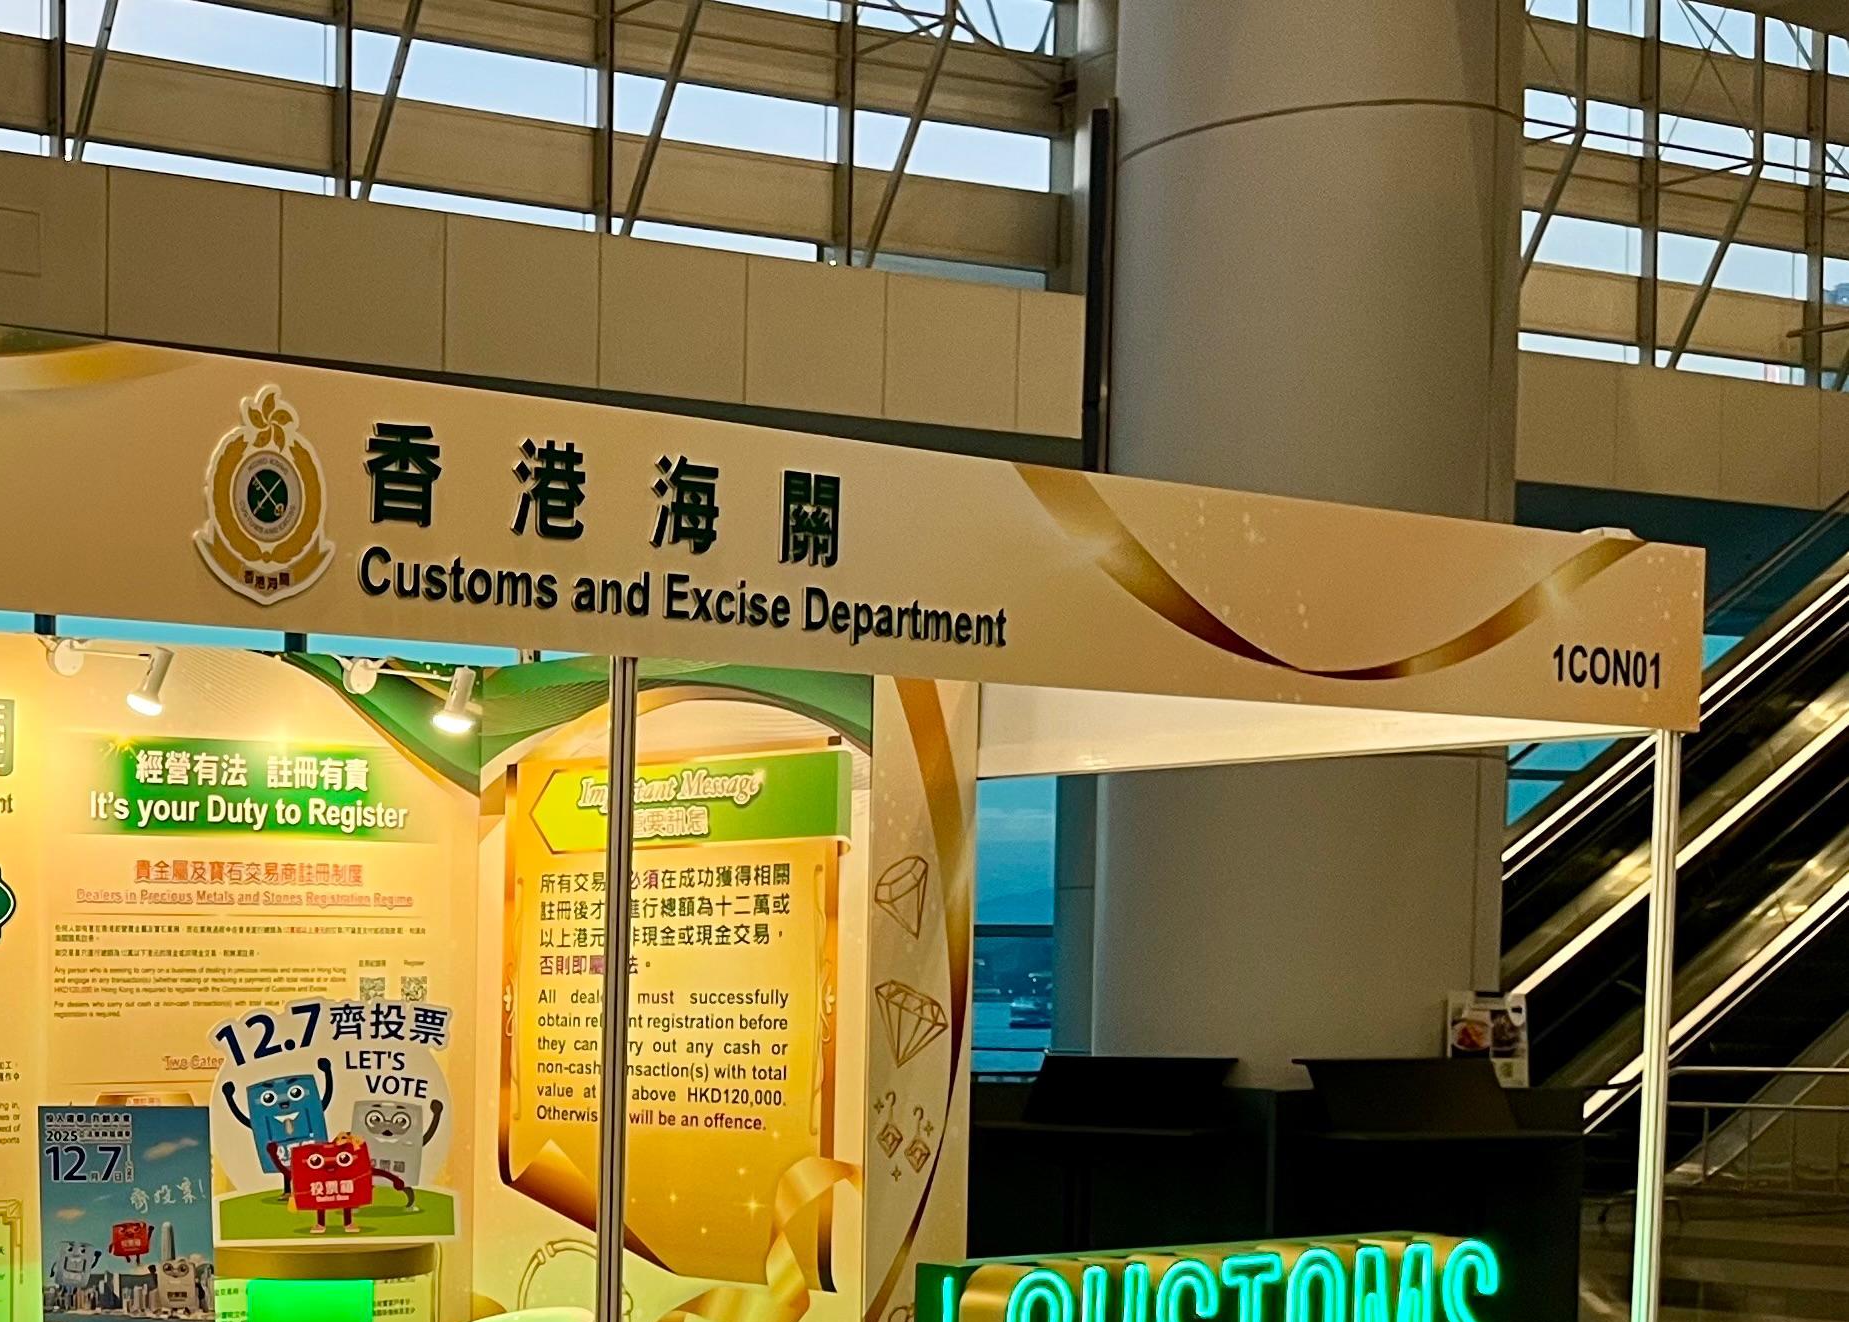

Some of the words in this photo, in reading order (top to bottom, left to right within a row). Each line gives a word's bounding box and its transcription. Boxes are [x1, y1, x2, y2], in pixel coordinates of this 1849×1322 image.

[363, 420, 843, 567] 香港海關
[358, 545, 558, 608] Customs
[572, 571, 646, 617] and
[663, 573, 791, 629] Excise
[803, 585, 1008, 647] Department
[1553, 644, 1662, 689] 1CON01
[135, 749, 248, 787] 經營有法
[266, 754, 369, 792] 註冊有責
[679, 770, 760, 803] Message
[89, 791, 129, 820] It's
[137, 795, 199, 828] your
[207, 794, 268, 832] Duty
[275, 798, 301, 825] to
[309, 798, 408, 834] Register
[540, 863, 791, 894] 所有交易必須在成功獲得相關
[540, 893, 790, 921] 註冊後才進行總額為十二萬或
[538, 989, 556, 1004] All
[638, 991, 674, 1004] must
[690, 989, 789, 1008] successfully
[216, 1003, 322, 1067] 12.7
[329, 1002, 449, 1047] 齊投票
[538, 1013, 581, 1027] obtain
[647, 1014, 734, 1032] registration
[739, 1015, 788, 1030] before
[345, 1051, 405, 1070] LET'S
[538, 1036, 565, 1054] they
[574, 1039, 598, 1051] can
[653, 1040, 677, 1053] out
[686, 1042, 714, 1057] any
[724, 1040, 761, 1055] cash
[771, 1043, 788, 1055] or
[538, 1061, 601, 1075] non-cash
[714, 1064, 746, 1079] with
[752, 1065, 787, 1081] total
[365, 1074, 428, 1098] VOTE
[537, 1083, 573, 1097] value
[583, 1084, 596, 1098] at
[632, 1086, 676, 1101] above
[687, 1087, 786, 1107] HKD120,000.
[537, 1105, 598, 1122] Otherwis
[629, 1110, 653, 1124] will
[658, 1110, 676, 1125] be
[681, 1113, 698, 1127] an
[704, 1112, 766, 1131] offence.
